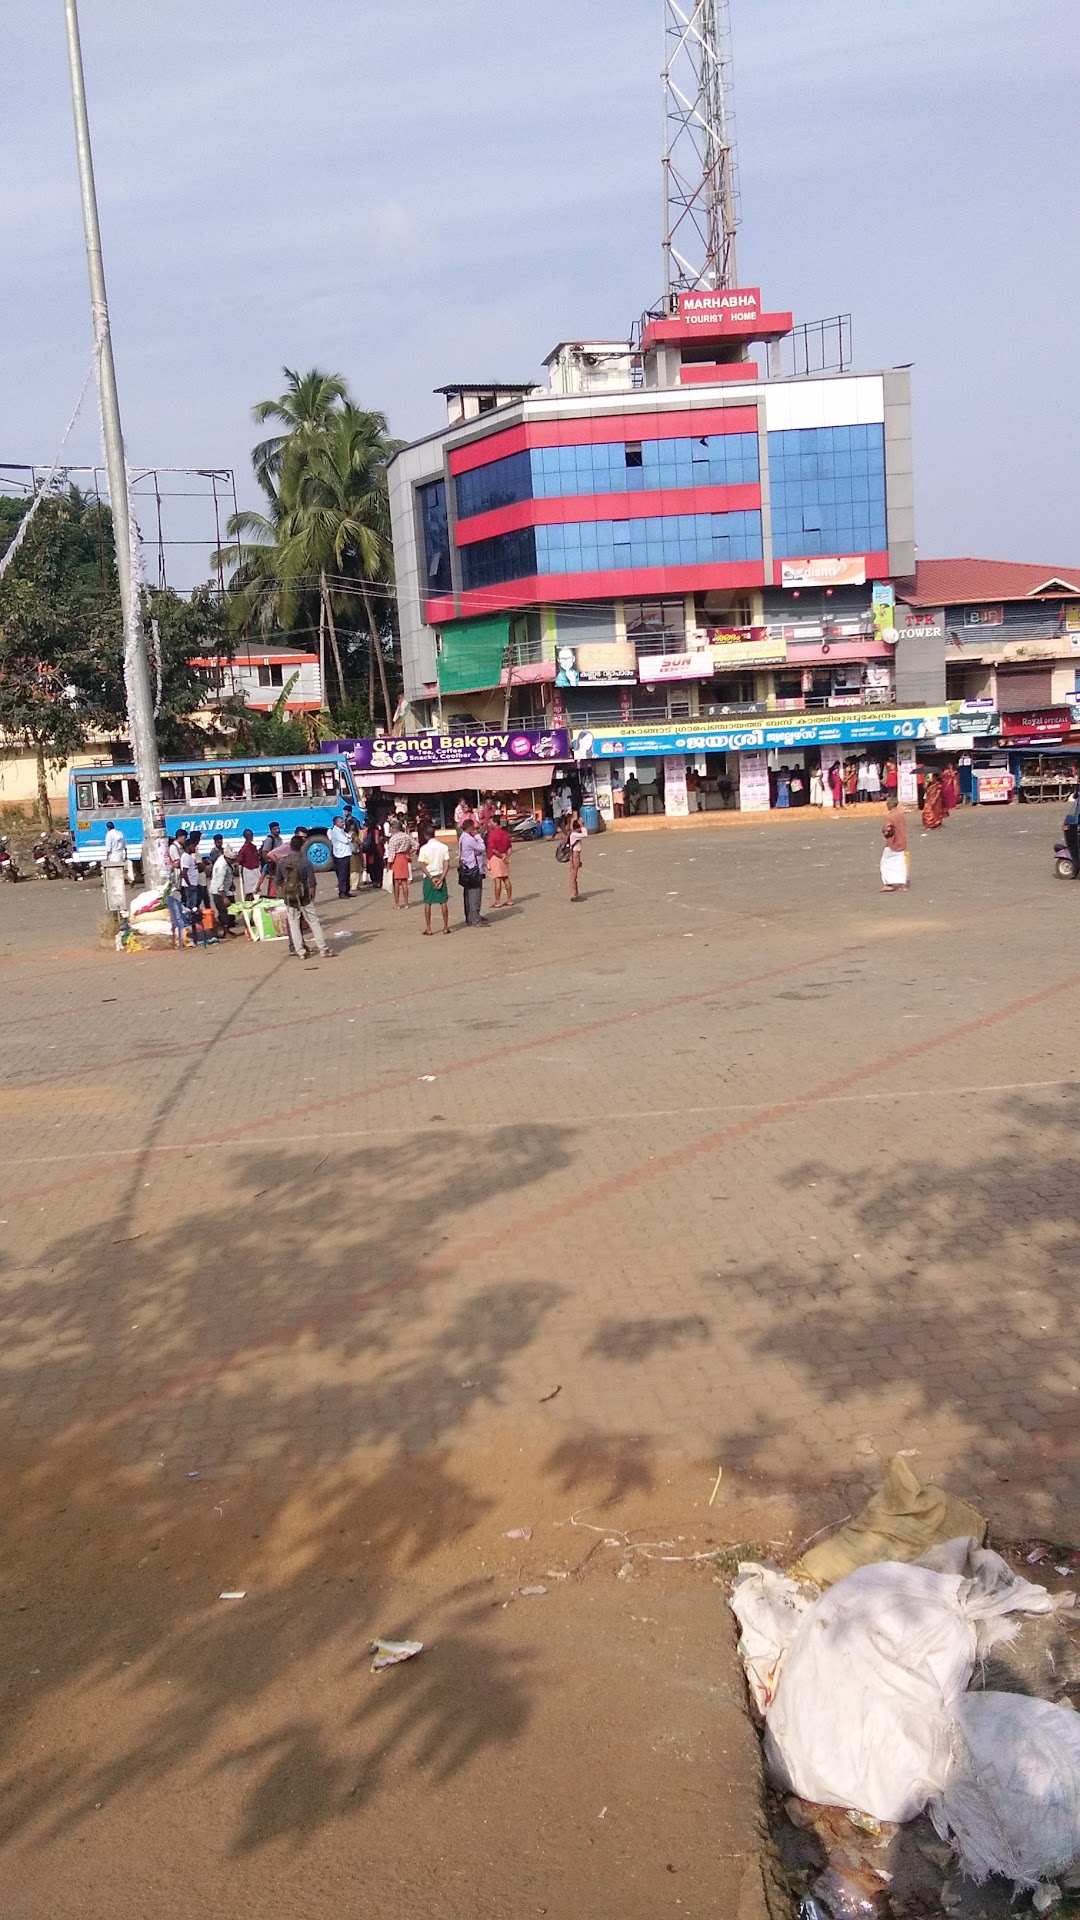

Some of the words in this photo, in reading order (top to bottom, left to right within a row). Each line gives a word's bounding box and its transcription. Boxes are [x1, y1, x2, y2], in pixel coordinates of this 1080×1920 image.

[684, 295, 756, 310] MARHABHA
[685, 314, 723, 324] TOURIST
[731, 312, 756, 321] HOME
[905, 614, 935, 626] TPK
[970, 610, 998, 623] BJP
[899, 627, 942, 639] TOWER
[662, 658, 691, 667] SUN
[1022, 717, 1043, 727] Royal
[1044, 716, 1068, 724] OPTICALS
[372, 738, 433, 752] Grand
[440, 734, 510, 749] Bakery
[181, 818, 239, 831] PLAYBOY
